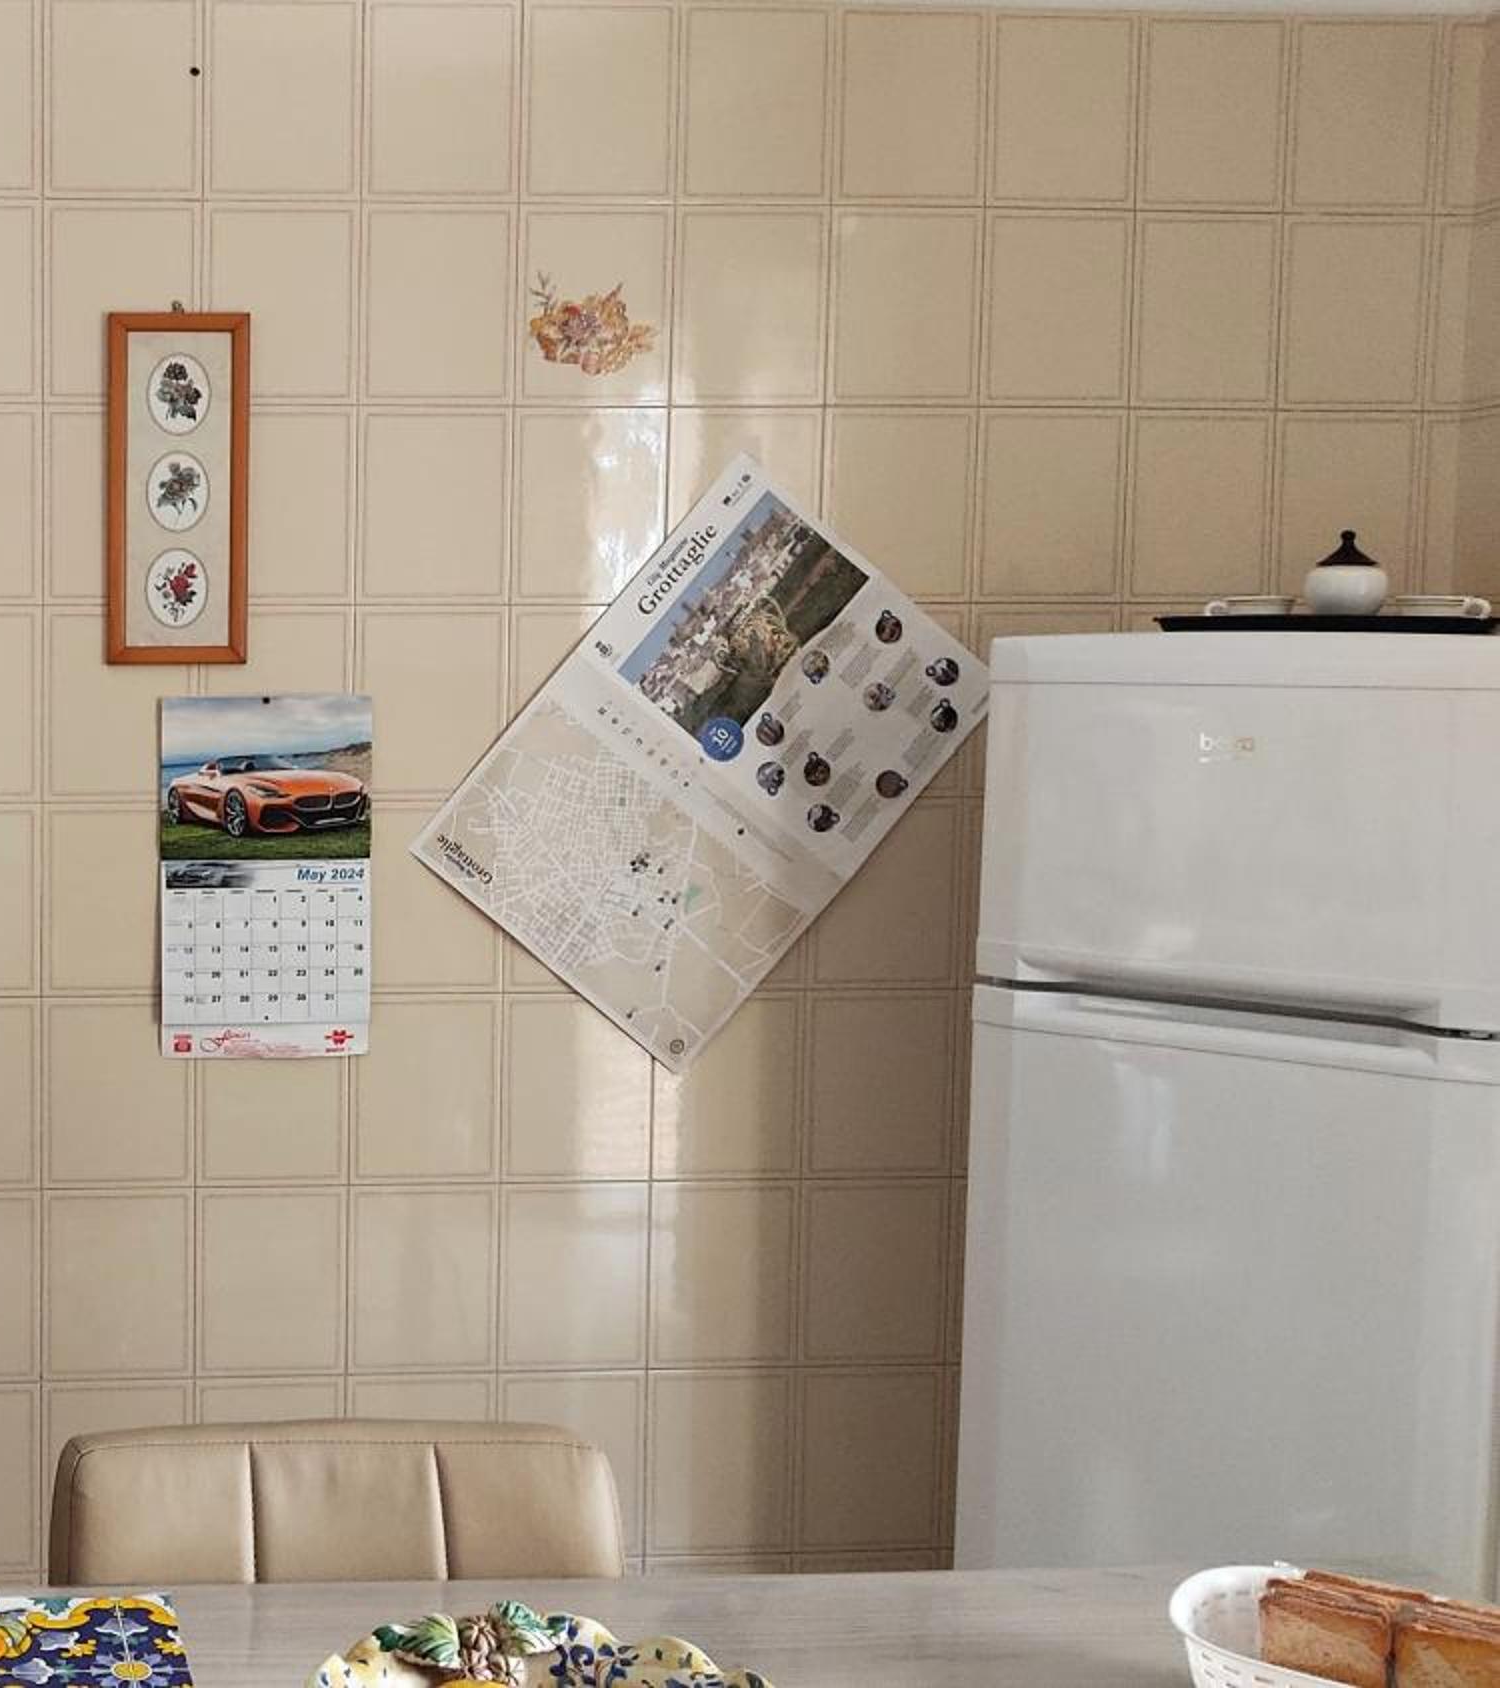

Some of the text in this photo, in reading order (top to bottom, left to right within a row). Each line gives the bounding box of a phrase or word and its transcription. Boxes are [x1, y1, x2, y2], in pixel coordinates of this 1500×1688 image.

[638, 525, 718, 615] Grottaglie
[711, 727, 729, 747] 10
[297, 867, 365, 881] May 2024
